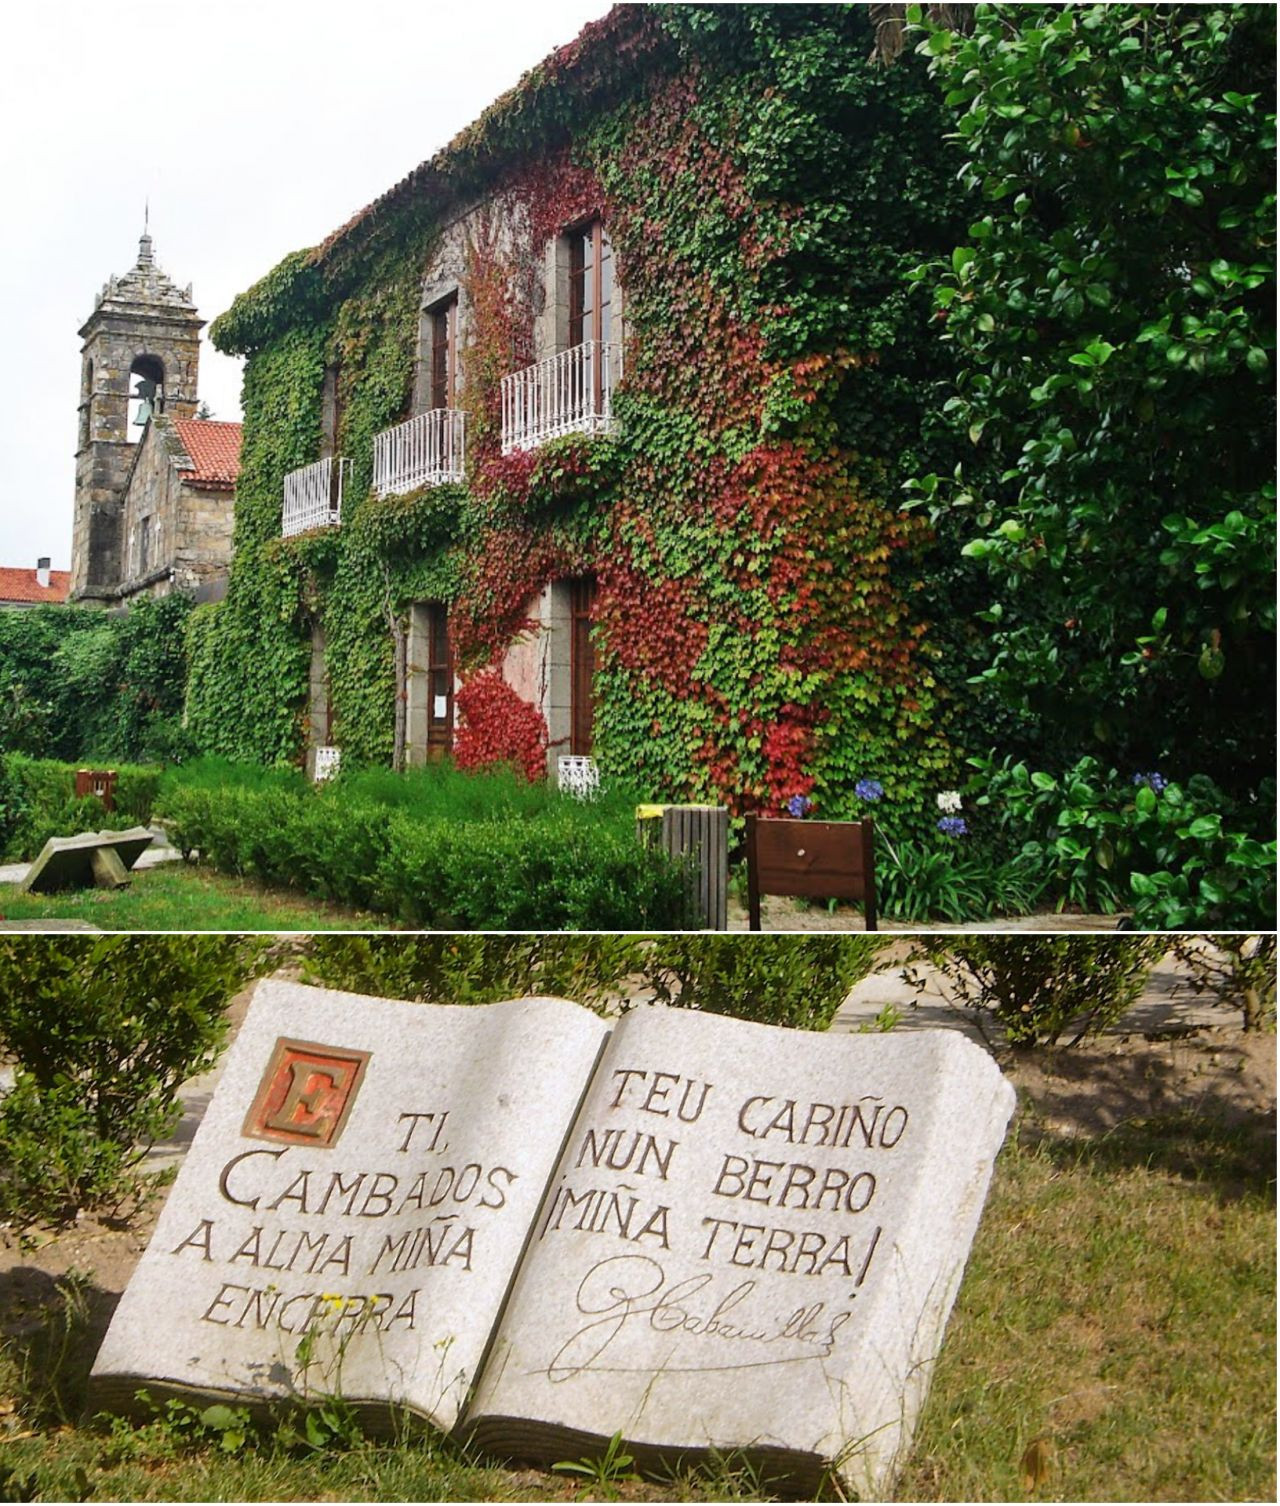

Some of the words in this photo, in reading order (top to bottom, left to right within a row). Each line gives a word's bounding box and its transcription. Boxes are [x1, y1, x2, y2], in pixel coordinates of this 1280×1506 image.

[265, 1061, 345, 1137] E
[611, 1069, 713, 1124] TEU
[738, 1095, 909, 1150] CARIÑO
[575, 1129, 680, 1181] NUN
[711, 1153, 877, 1214] BERRO
[171, 1218, 216, 1262] A
[228, 1225, 354, 1276] ALMA
[368, 1214, 477, 1276] MIÑA
[700, 1216, 882, 1299] TERRA!
